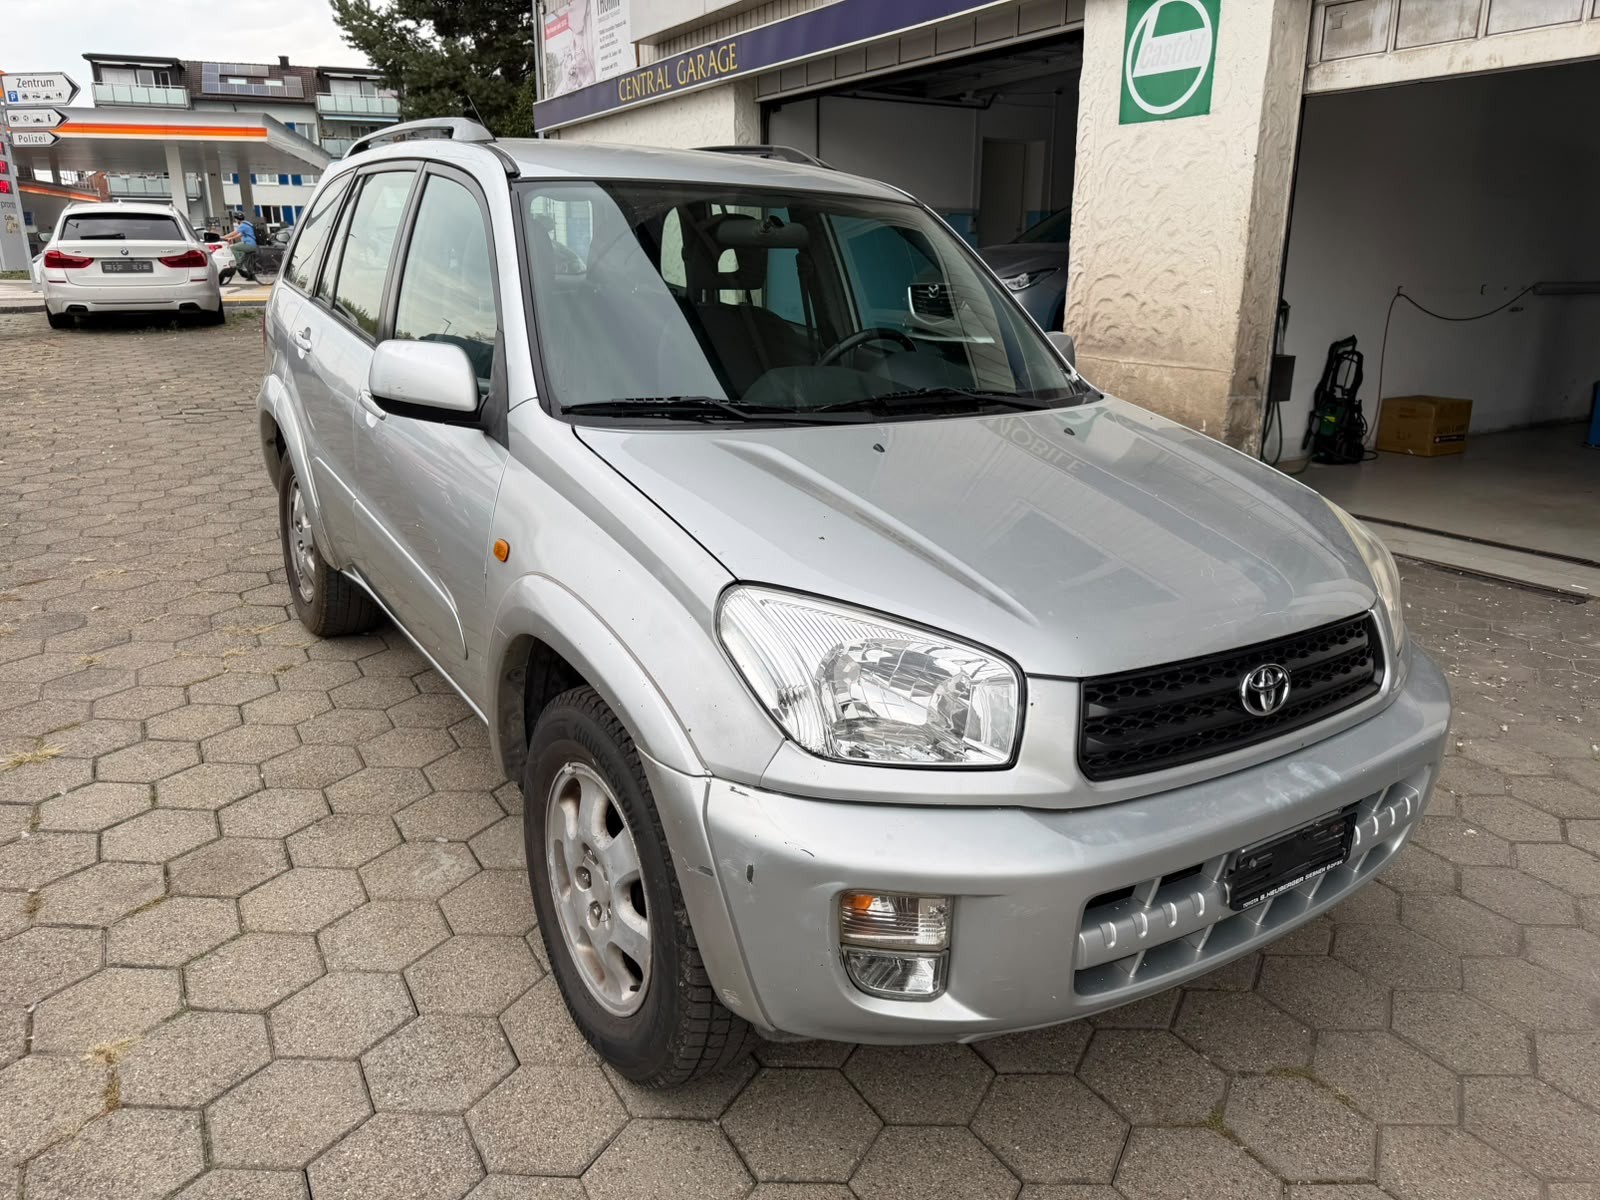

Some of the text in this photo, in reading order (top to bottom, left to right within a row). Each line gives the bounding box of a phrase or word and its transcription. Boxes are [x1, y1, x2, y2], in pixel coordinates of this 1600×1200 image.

[1140, 33, 1206, 69] Castrol
[16, 78, 55, 89] Zentrum
[618, 43, 738, 101] CENTRAL GARAGE
[18, 134, 47, 144] Polizei
